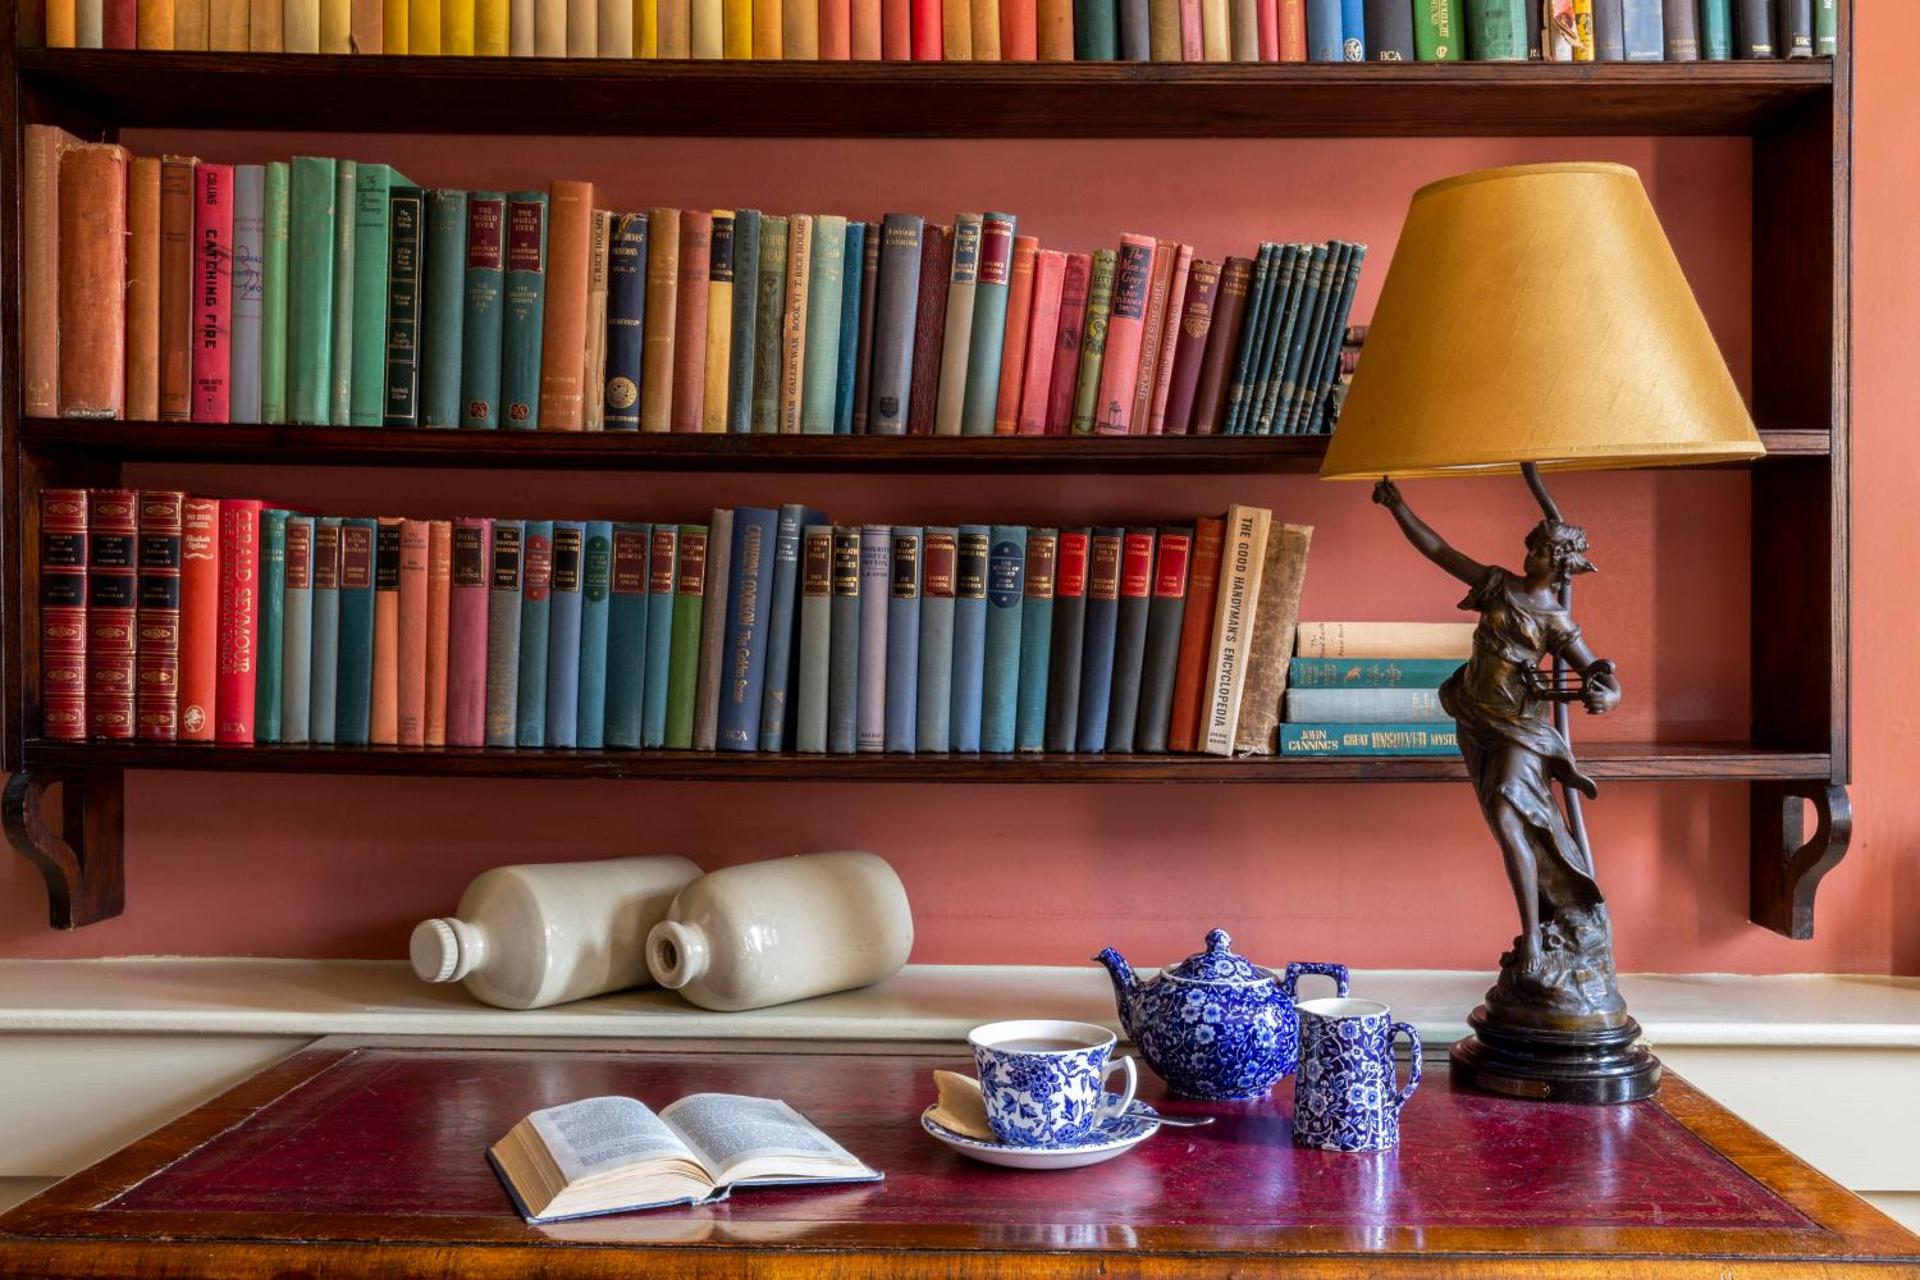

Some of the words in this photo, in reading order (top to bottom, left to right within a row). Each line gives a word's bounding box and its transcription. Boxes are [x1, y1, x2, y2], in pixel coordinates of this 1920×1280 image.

[1380, 51, 1402, 61] BCA
[206, 172, 218, 205] COLLINS
[472, 214, 498, 222] WORLD
[512, 217, 538, 225] WORLD
[516, 224, 535, 232] OVER
[595, 214, 604, 247] HOLMES
[796, 256, 804, 277] RICE
[1128, 247, 1144, 259] The
[204, 230, 218, 307] CATCHING
[1154, 279, 1165, 304] THE
[203, 313, 218, 349] FIRE
[792, 305, 802, 332] BOOK
[790, 336, 800, 361] WAR
[788, 361, 799, 394] GALLIC
[224, 510, 234, 533] THE
[1239, 517, 1254, 539] THE
[239, 510, 253, 581] GERALD
[743, 524, 762, 576] CATHERINE
[1235, 541, 1250, 573] GOOD
[223, 537, 234, 626] JOURNEYMAN
[738, 578, 758, 627] COOKSON
[1225, 576, 1246, 643] HANDYMAN'S
[236, 586, 252, 674] SEYMOUR
[222, 629, 233, 675] TAILOR
[1214, 647, 1236, 728] ENCYCLOPEDIA
[726, 729, 748, 741] BCA
[1301, 729, 1327, 740] JOHN
[1343, 733, 1369, 746] GREAT
[1372, 731, 1427, 748] UNSOLVED
